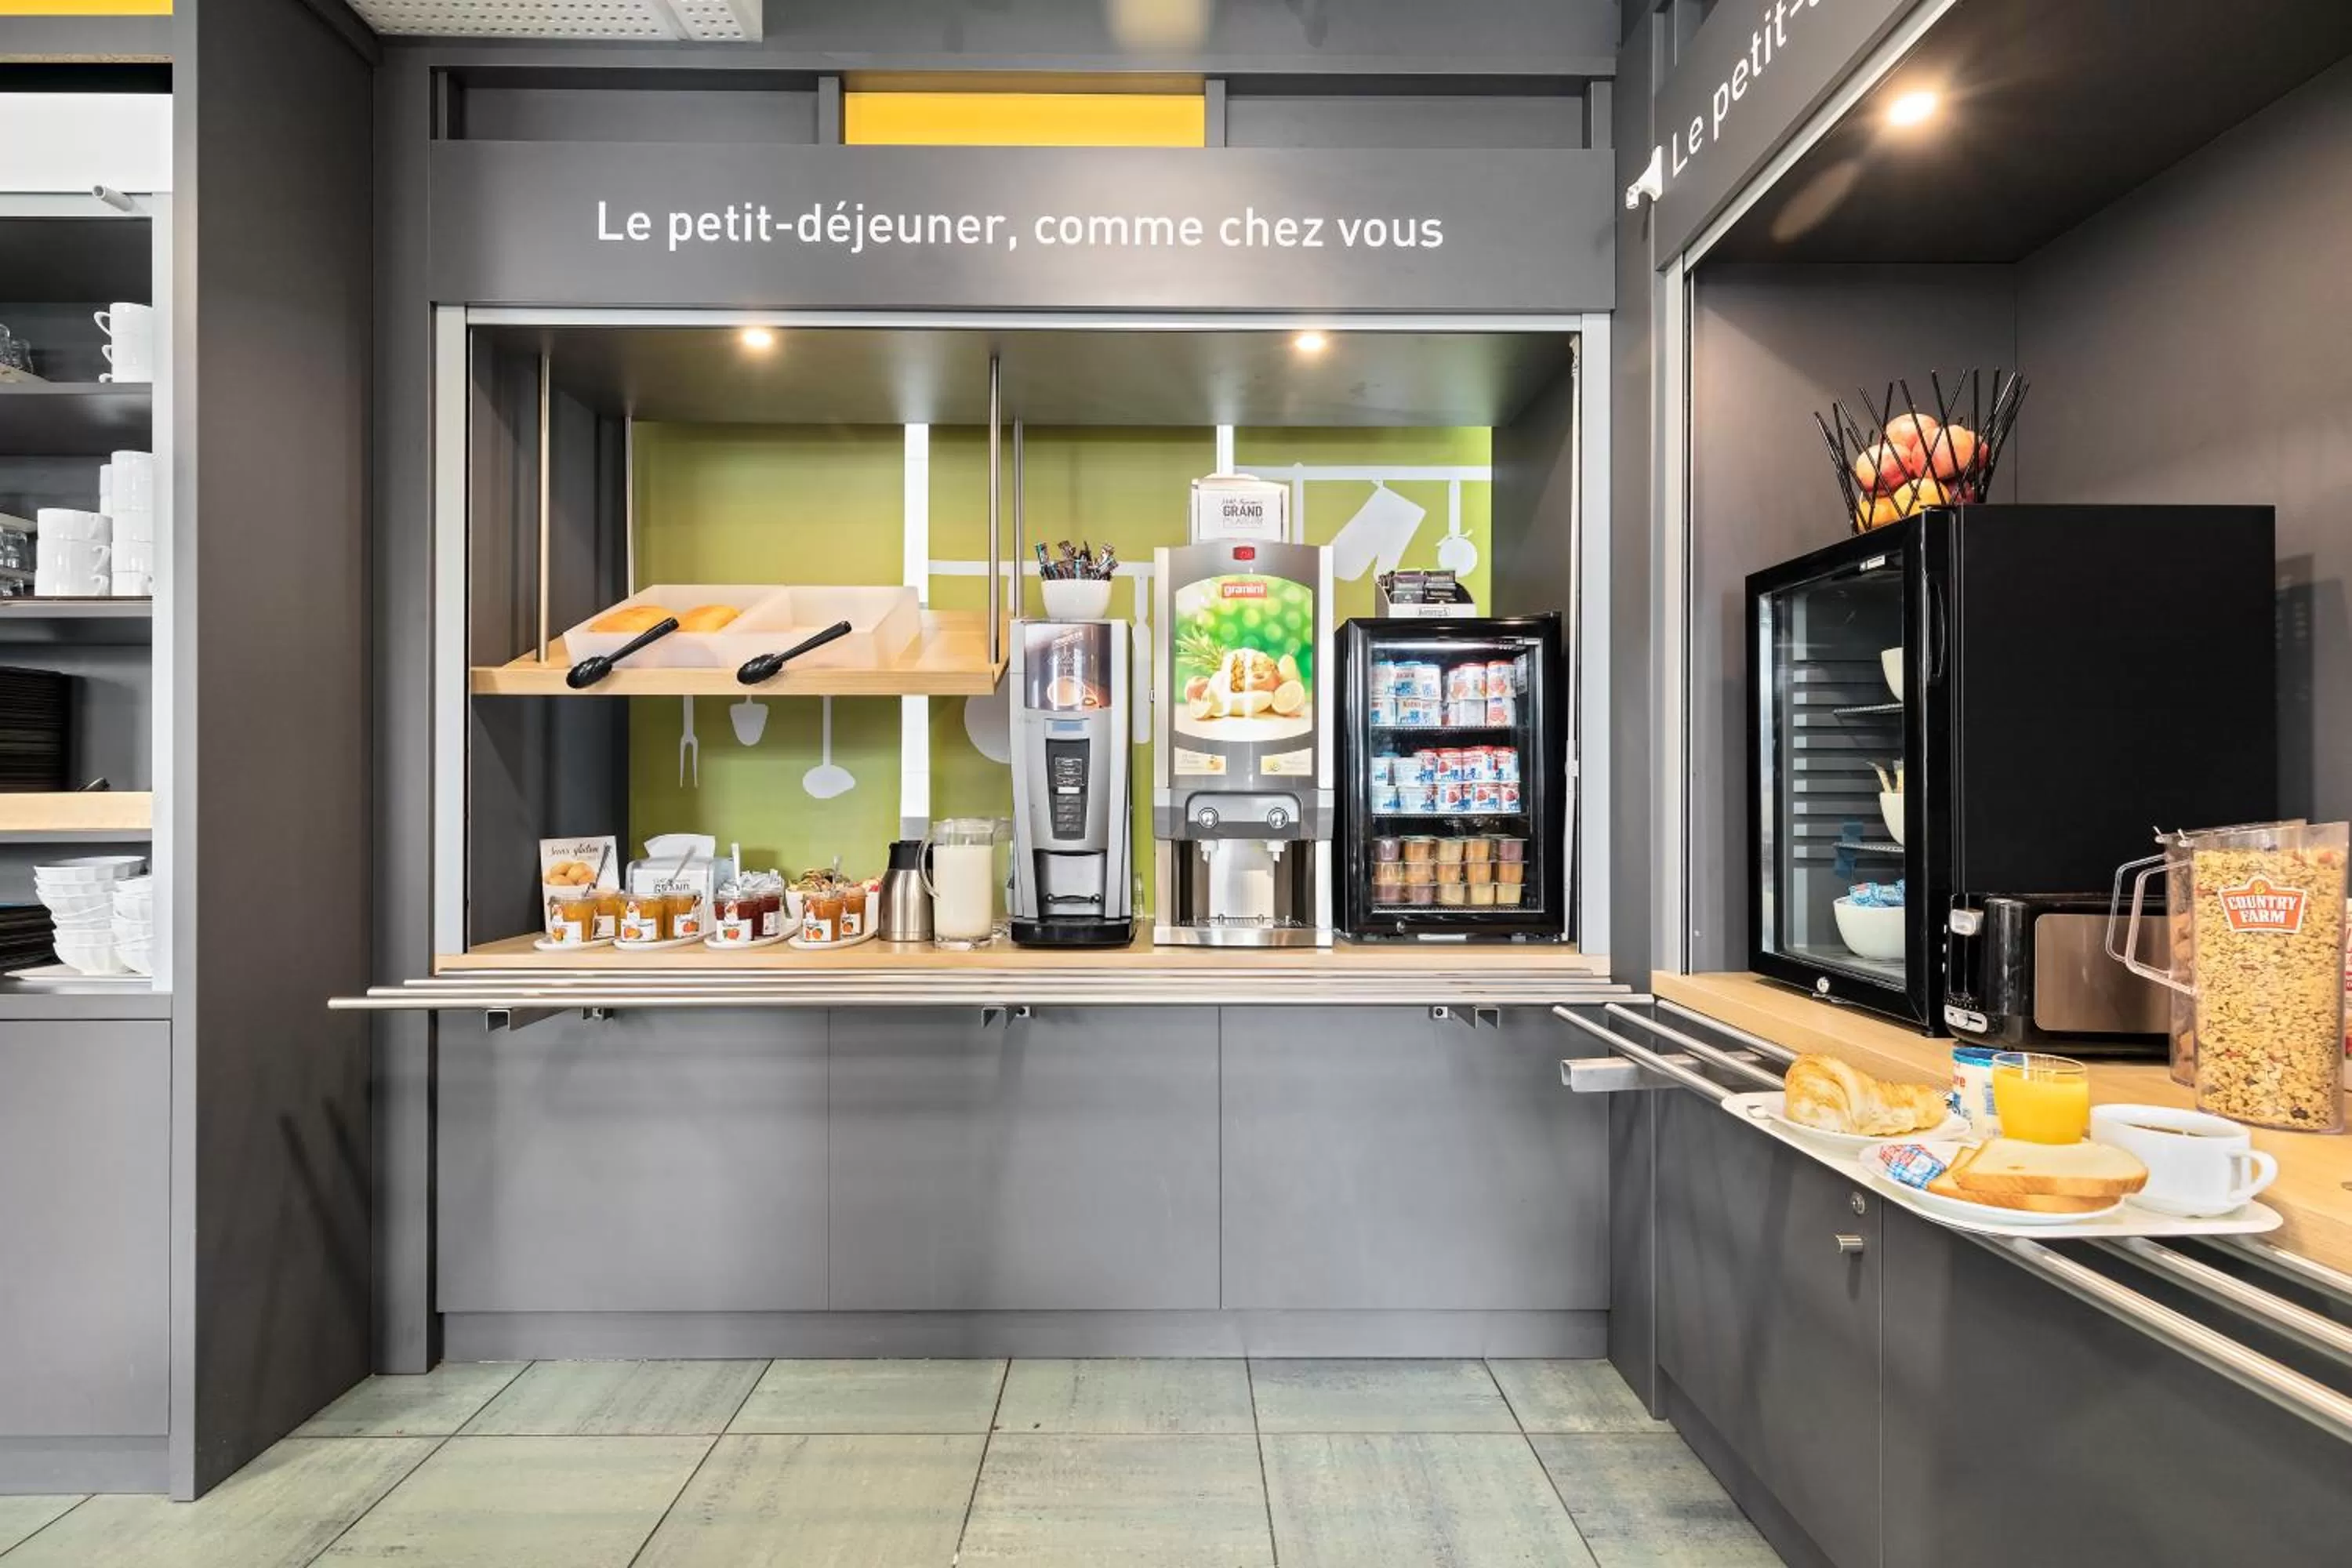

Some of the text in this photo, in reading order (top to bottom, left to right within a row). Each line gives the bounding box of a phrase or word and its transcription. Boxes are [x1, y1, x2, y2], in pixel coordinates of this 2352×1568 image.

[1671, 0, 1819, 178] Le petit-
[598, 201, 1443, 252] Le petit-déjeuner, comme chez vous
[1223, 506, 1263, 517] GRAND
[2227, 895, 2298, 910] COUNTRY
[2240, 909, 2286, 924] FARM
